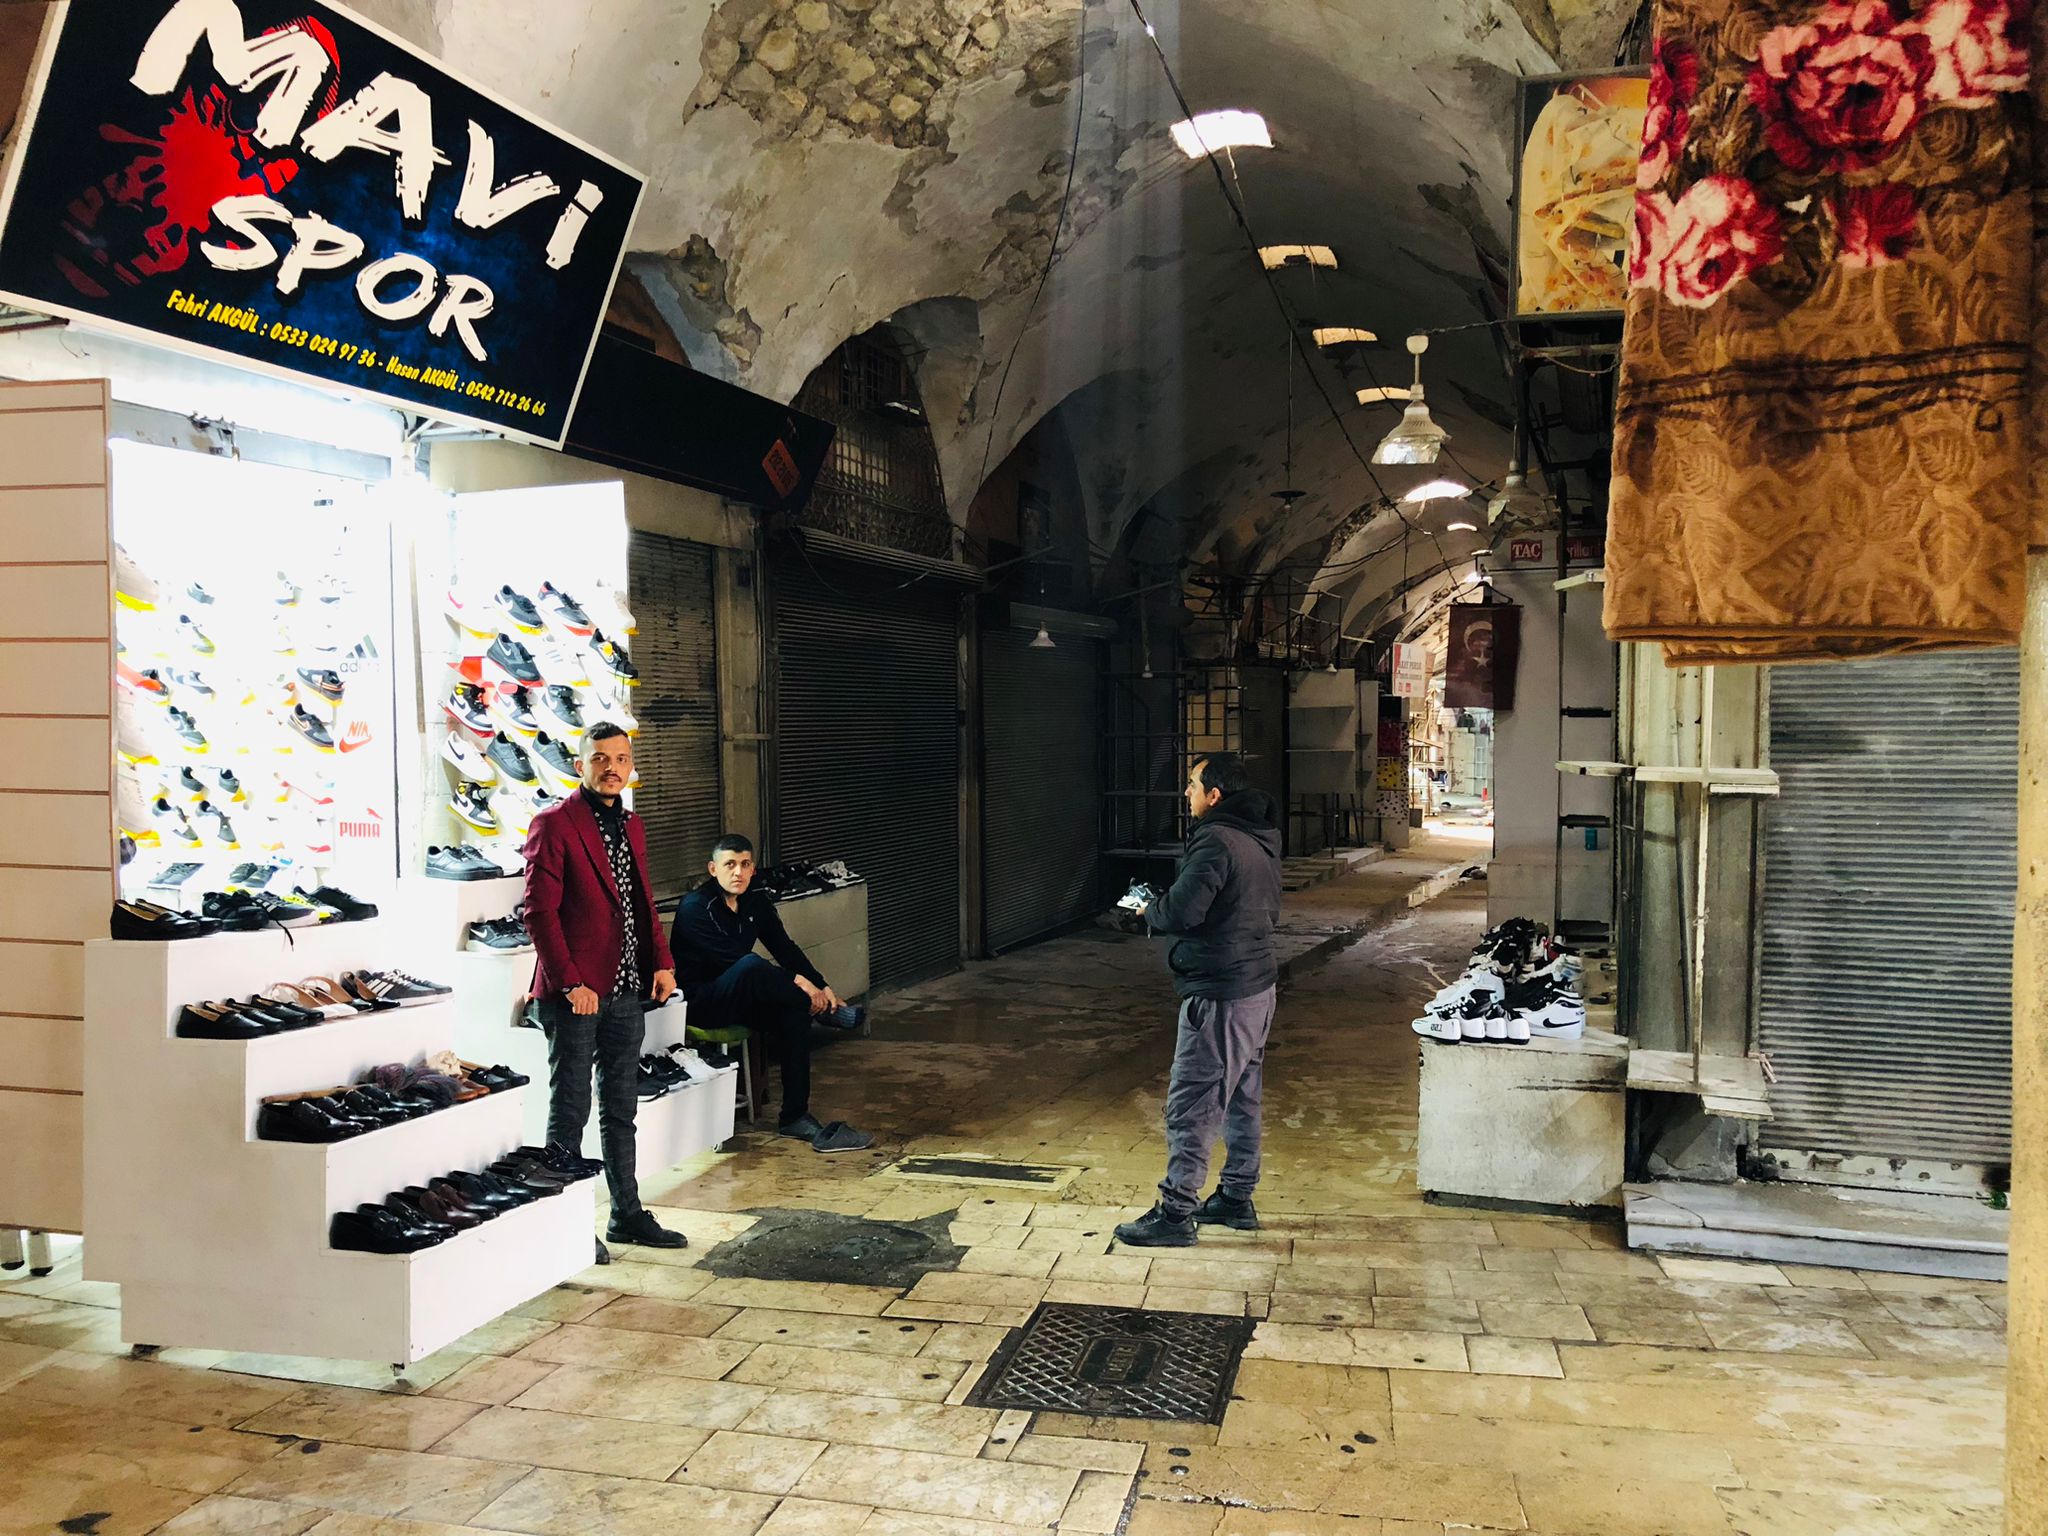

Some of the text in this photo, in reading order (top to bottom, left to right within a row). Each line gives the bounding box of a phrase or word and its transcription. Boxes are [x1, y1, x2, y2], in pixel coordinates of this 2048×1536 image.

[201, 195, 493, 361] SPOR
[166, 289, 209, 318] Fahri
[207, 303, 260, 334] AKGÜL
[270, 322, 308, 347] 0533
[309, 334, 338, 356] 024
[339, 343, 358, 361] 97
[358, 349, 377, 368] 36
[386, 356, 420, 380] Hasan
[420, 366, 459, 391] AKGÜL
[466, 381, 496, 401] 0542
[495, 389, 518, 408] 712
[517, 396, 531, 412] 26
[532, 402, 546, 416] 66
[339, 821, 380, 837] PUMA
